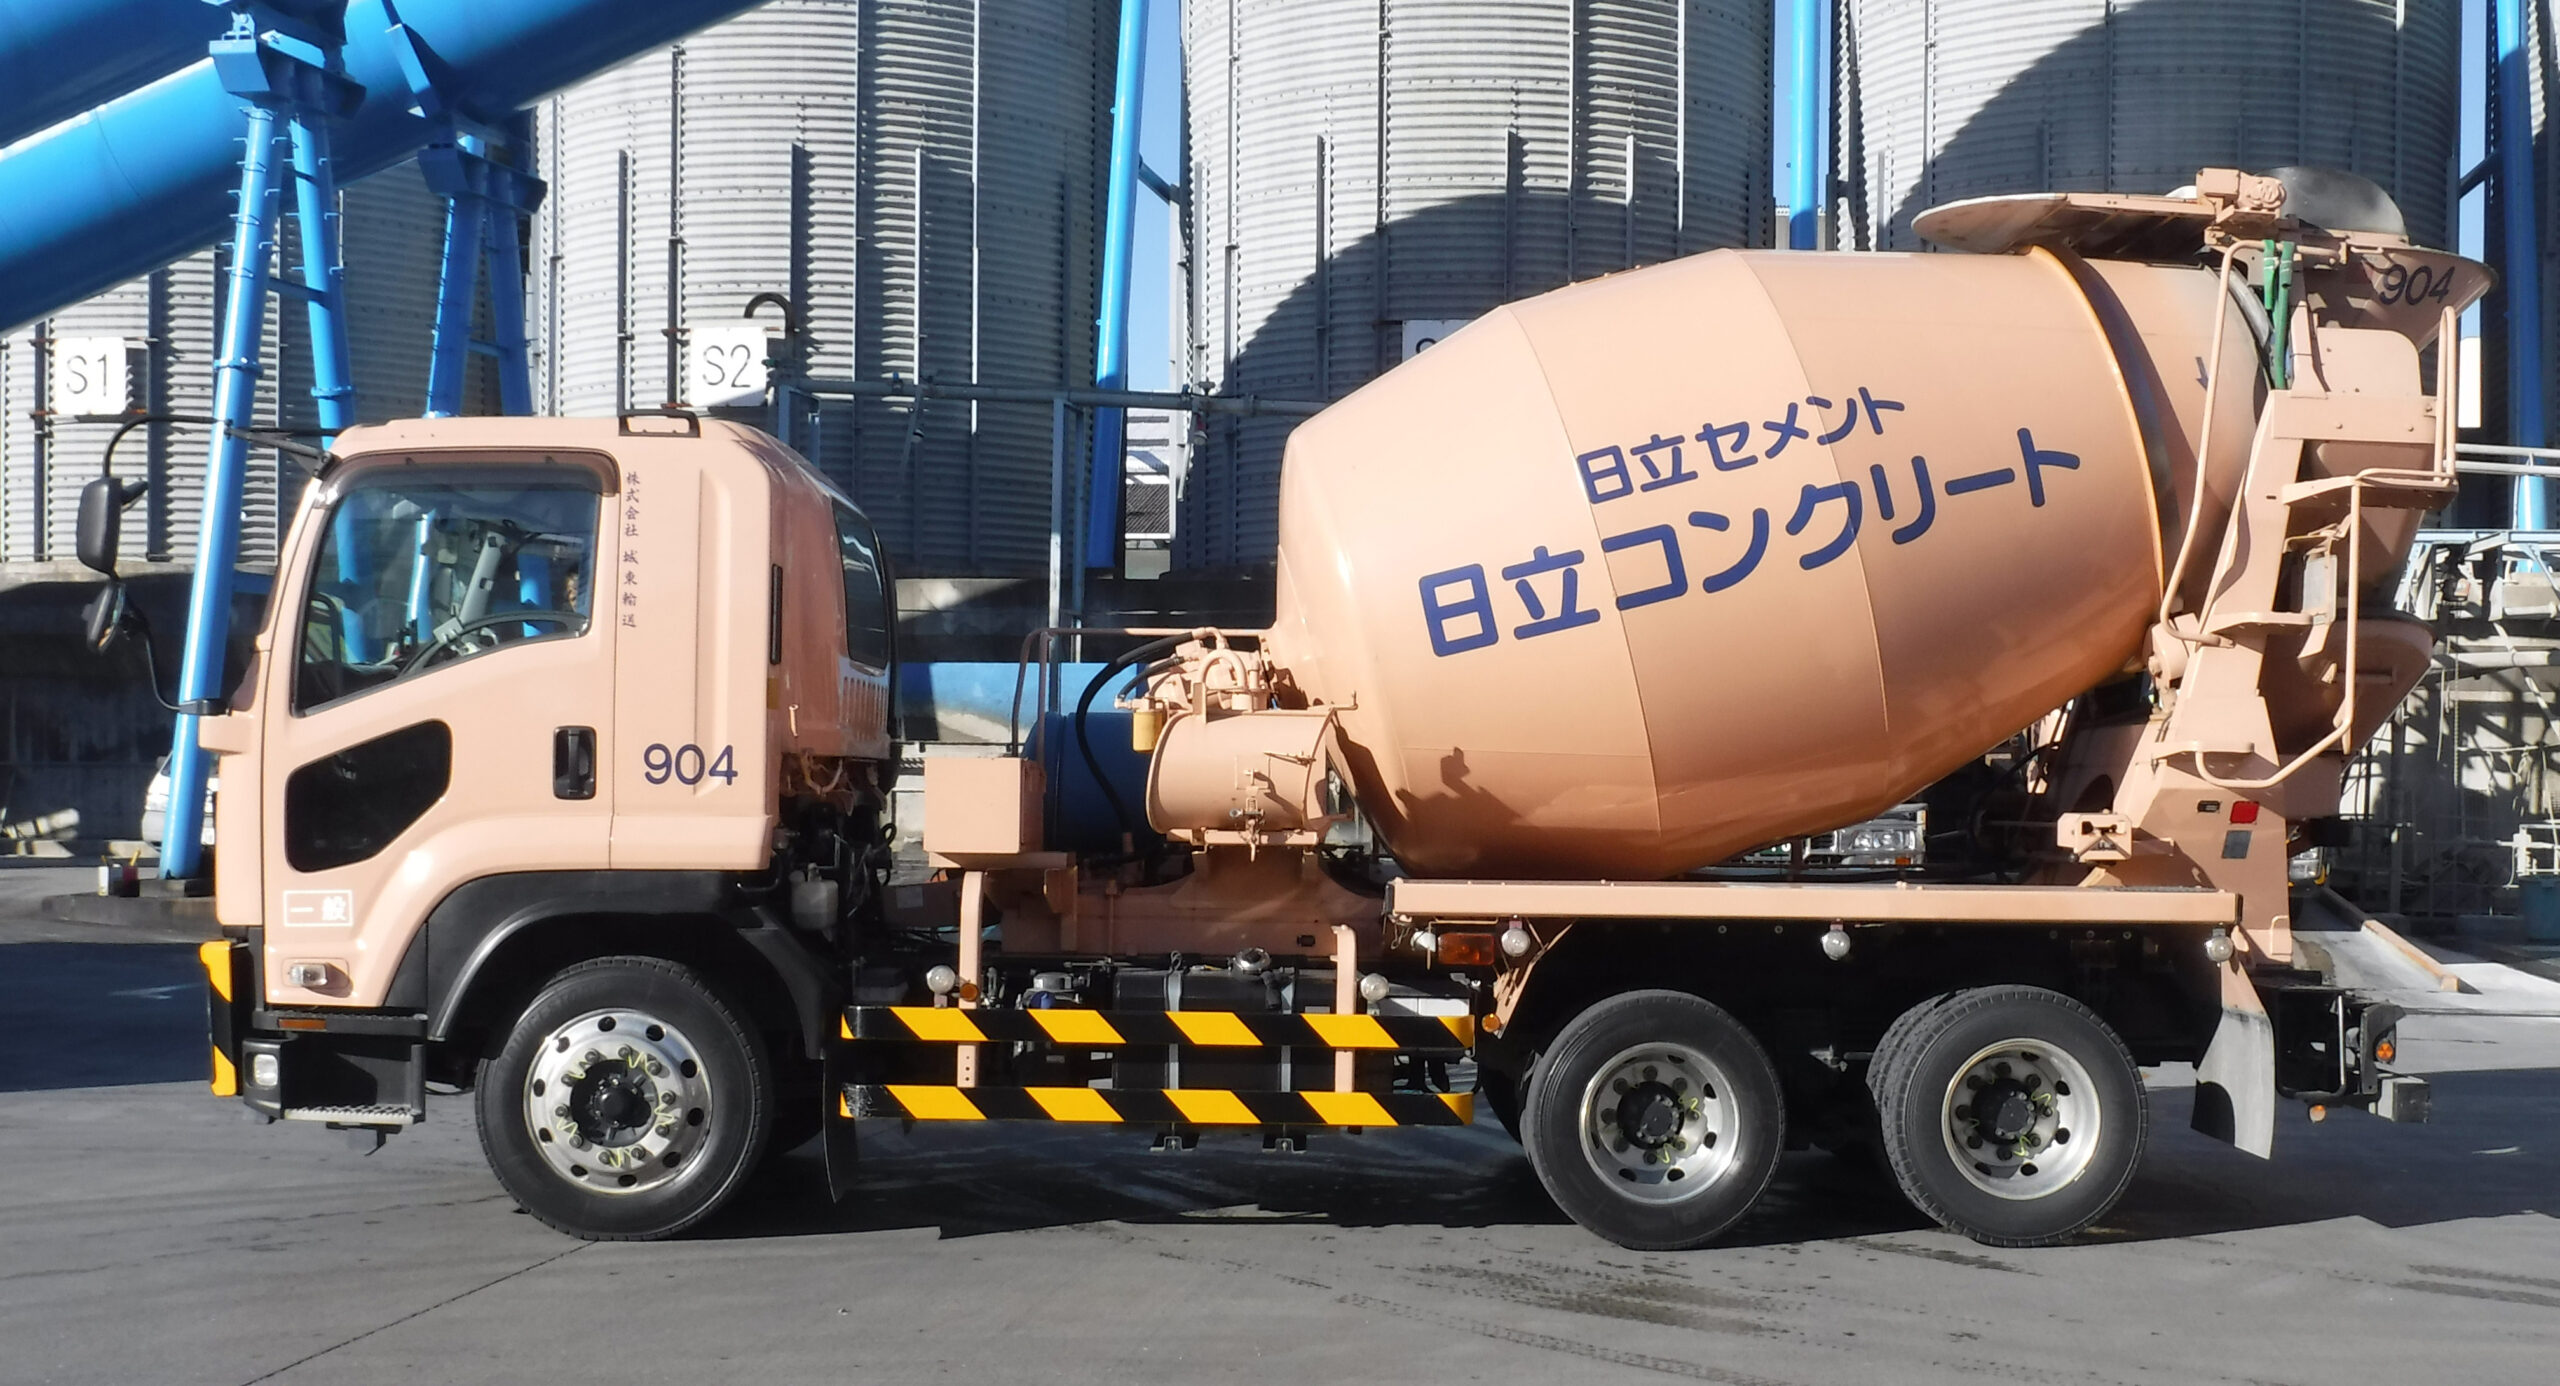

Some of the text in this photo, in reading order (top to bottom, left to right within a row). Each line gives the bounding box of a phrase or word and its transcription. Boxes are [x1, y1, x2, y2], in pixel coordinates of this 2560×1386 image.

[2380, 263, 2455, 305] 904
[66, 353, 107, 397] S1
[702, 344, 751, 388] S2
[1576, 386, 1905, 504] 日立セメント
[625, 471, 641, 537] 株式会社
[1418, 427, 2080, 658] 日立コンクリート
[643, 743, 738, 786] 904
